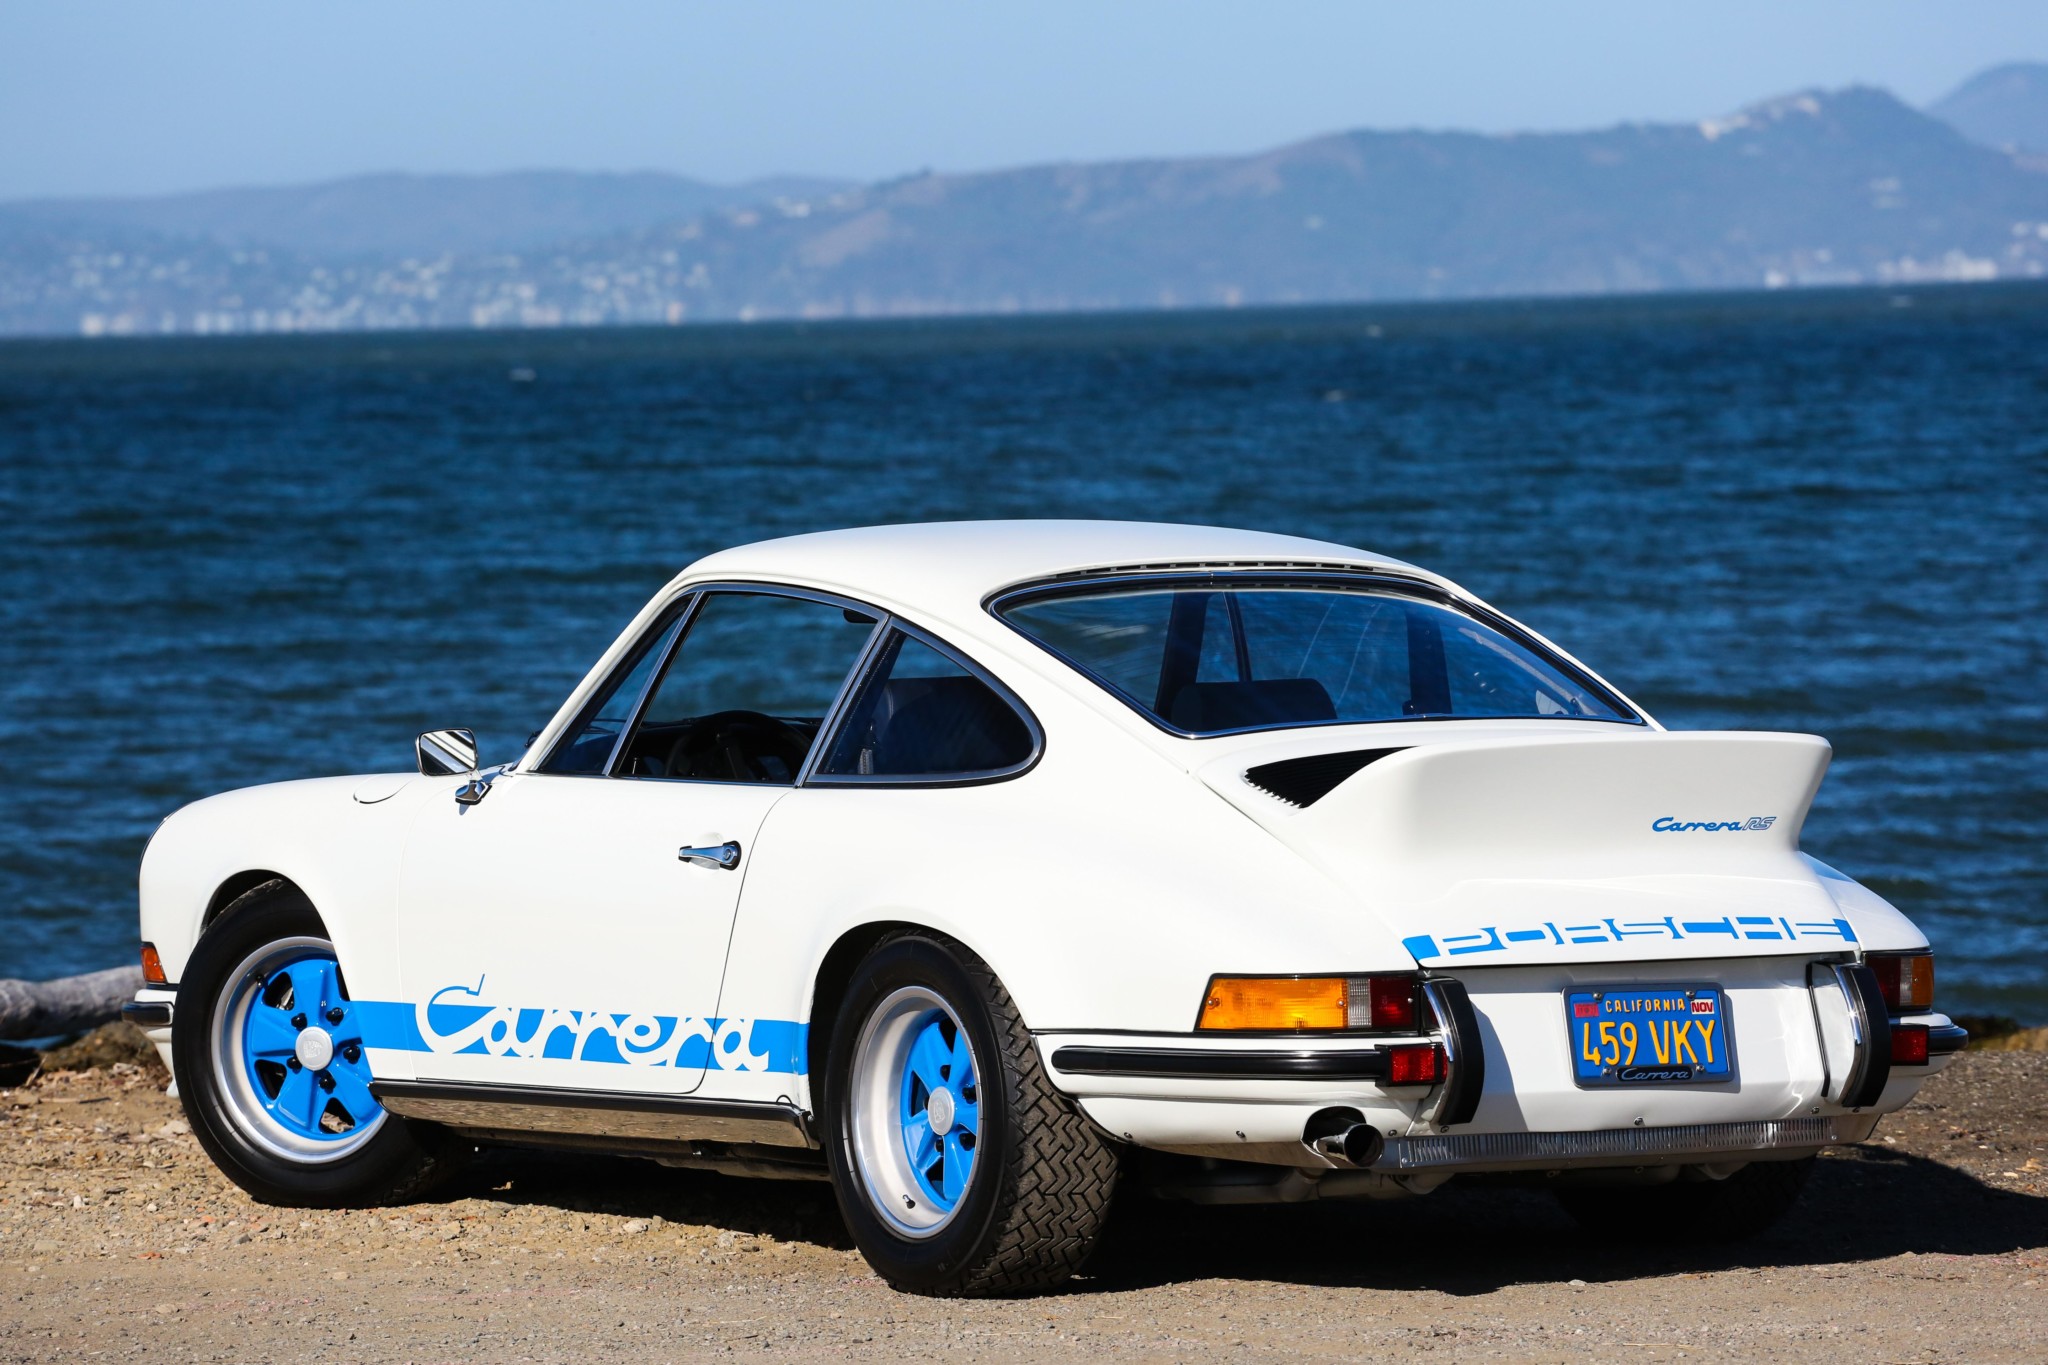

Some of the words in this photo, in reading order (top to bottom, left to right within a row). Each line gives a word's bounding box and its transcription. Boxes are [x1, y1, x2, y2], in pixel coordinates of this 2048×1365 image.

[1652, 816, 1743, 832] Carrera
[1742, 816, 1777, 831] RS
[1428, 915, 1846, 957] PORSCHE
[1605, 998, 1686, 1013] CALIFORNIA
[1691, 1001, 1714, 1013] NOV
[415, 973, 770, 1073] Carrera
[1583, 1021, 1638, 1066] 459
[1648, 1019, 1716, 1065] VKY
[1621, 1068, 1690, 1081] Carrera
